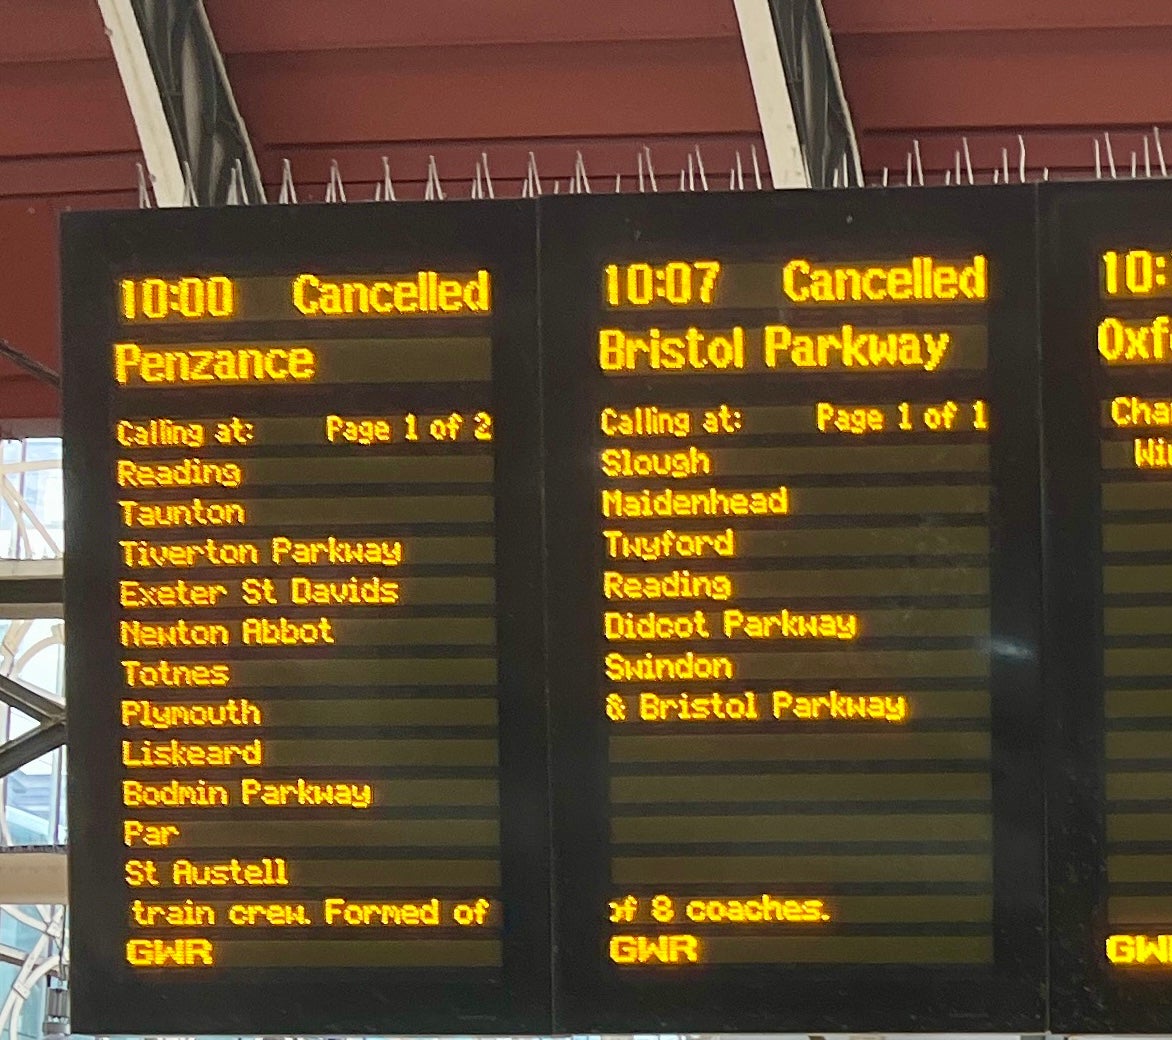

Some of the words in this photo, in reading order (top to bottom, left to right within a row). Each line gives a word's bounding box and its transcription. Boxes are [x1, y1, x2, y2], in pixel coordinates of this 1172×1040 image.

[122, 277, 233, 318] 10:00
[293, 271, 488, 316] Cancelled
[606, 262, 720, 305] 10:07
[783, 255, 985, 301] Cancelled
[600, 327, 743, 370] Bristol
[765, 325, 949, 370] Parkway
[115, 344, 315, 383] Penzance
[117, 419, 204, 447] Calling
[215, 417, 253, 443] at:
[327, 416, 389, 444] Page
[406, 414, 417, 440] 1
[430, 413, 462, 440] of
[474, 412, 491, 439] 2
[601, 407, 689, 436] Calling
[703, 405, 741, 432] at:
[118, 458, 241, 486] Reading
[602, 447, 709, 478] Slough
[120, 499, 245, 526] Taunton
[603, 487, 788, 517] Maidenhead
[120, 539, 258, 567] Tiverton
[273, 537, 401, 565] Parkway
[603, 529, 734, 560] Twyford
[120, 580, 227, 607] Exeter
[242, 579, 277, 604] St
[292, 577, 398, 604] Davids
[604, 570, 731, 600] Reading
[120, 620, 229, 646] Newton
[243, 618, 334, 645] Abbot
[605, 611, 709, 639] Didcot
[724, 609, 857, 639] Parkway
[122, 661, 229, 686] Totnes
[605, 652, 733, 681] Swindon
[122, 699, 260, 728] Plymouth
[606, 694, 625, 720] &
[640, 692, 757, 720] Bristol
[773, 691, 907, 720] Parkway
[123, 740, 261, 766] Liskeard
[123, 780, 227, 805] Bodmin
[242, 779, 371, 808] Parkway
[124, 821, 179, 846] Par
[126, 861, 159, 885] St
[173, 859, 288, 885] Austell
[132, 900, 215, 925] train
[229, 905, 311, 924] crew.
[325, 899, 439, 924] Formed
[454, 899, 489, 924] of
[651, 895, 674, 922] 8
[686, 895, 830, 922] coaches.
[127, 939, 213, 965] GWR
[610, 935, 698, 962] GWR
